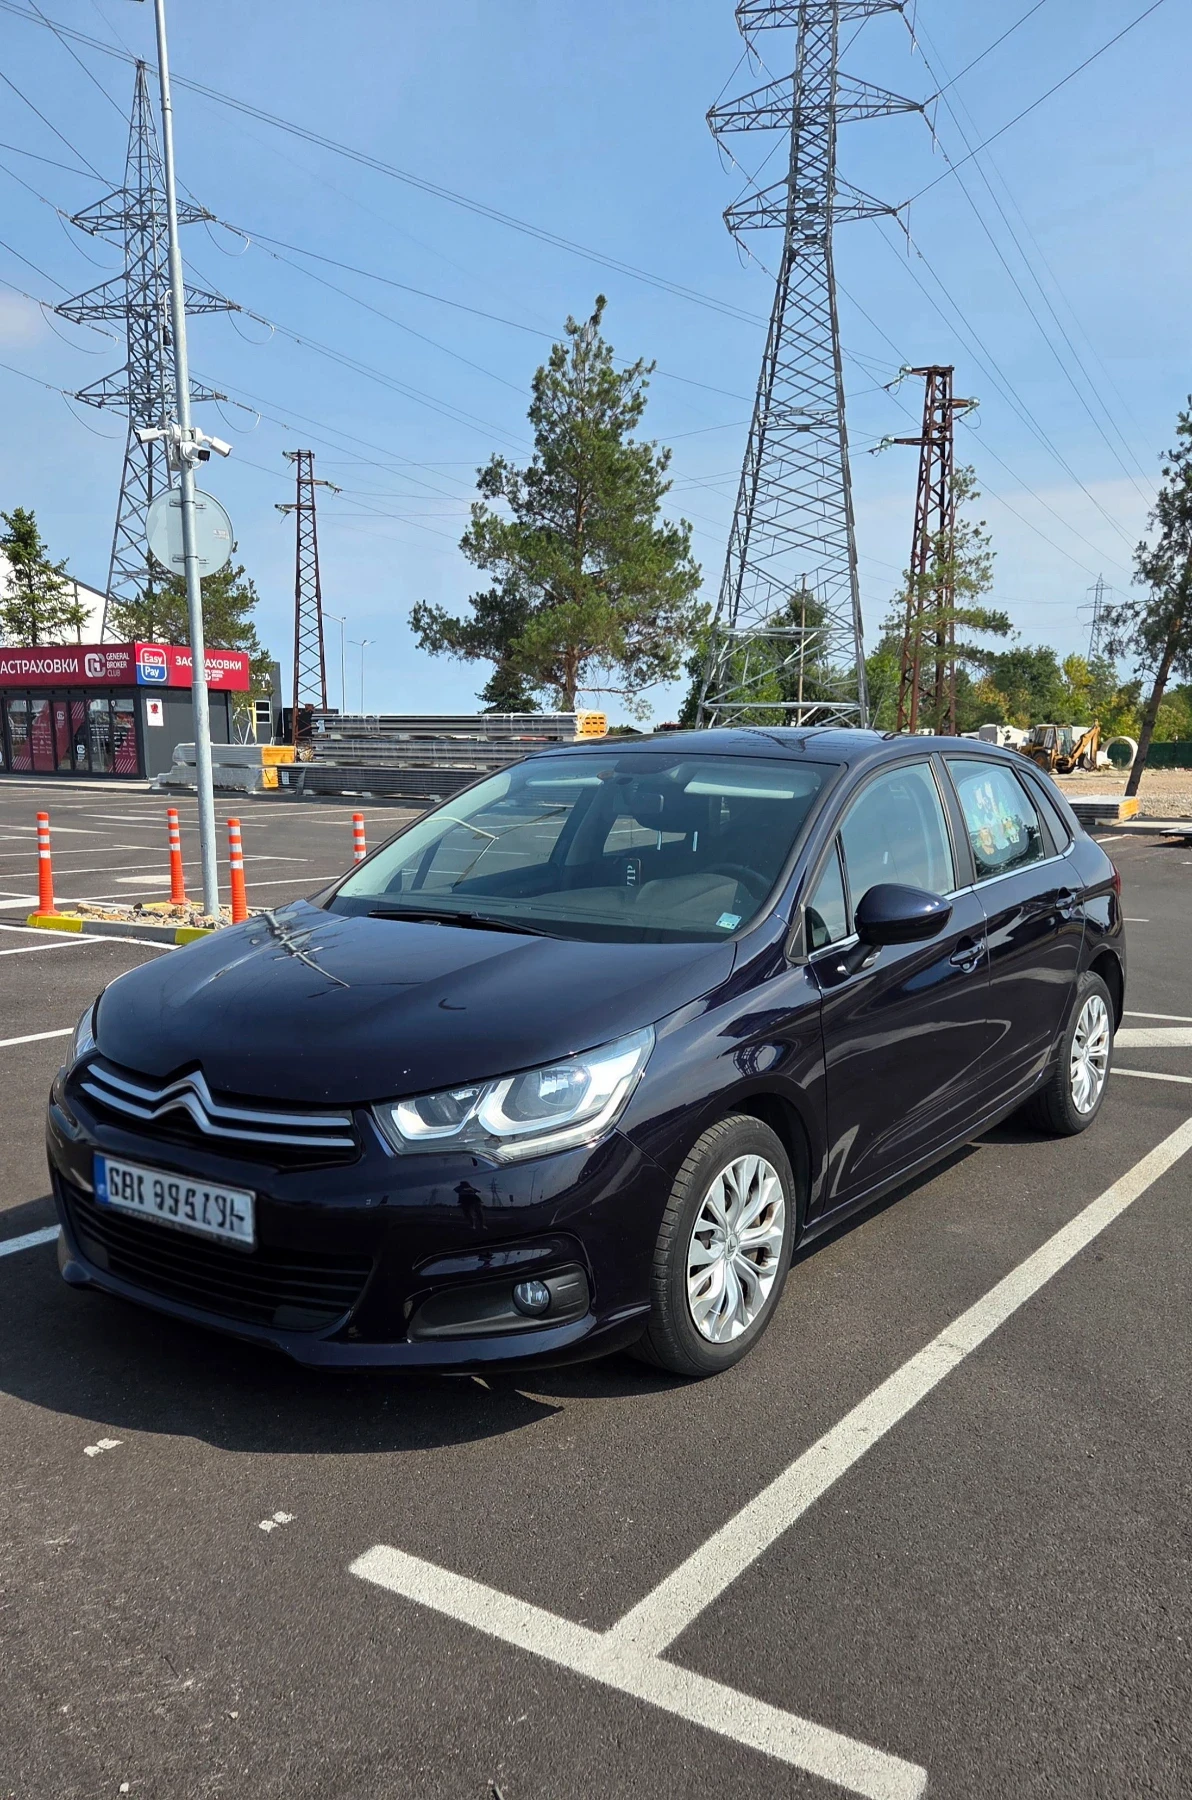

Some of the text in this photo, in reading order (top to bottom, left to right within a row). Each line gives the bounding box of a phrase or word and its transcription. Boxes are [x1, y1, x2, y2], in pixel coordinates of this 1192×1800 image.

[106, 652, 130, 660] GENERAL
[144, 653, 163, 664] Easy
[0, 658, 79, 674] АСТРАХОВКИ
[106, 660, 128, 669] BROKER
[175, 656, 242, 670] ЗАСАХОВКИ
[107, 669, 121, 677] CLUB
[145, 666, 159, 678] Pay
